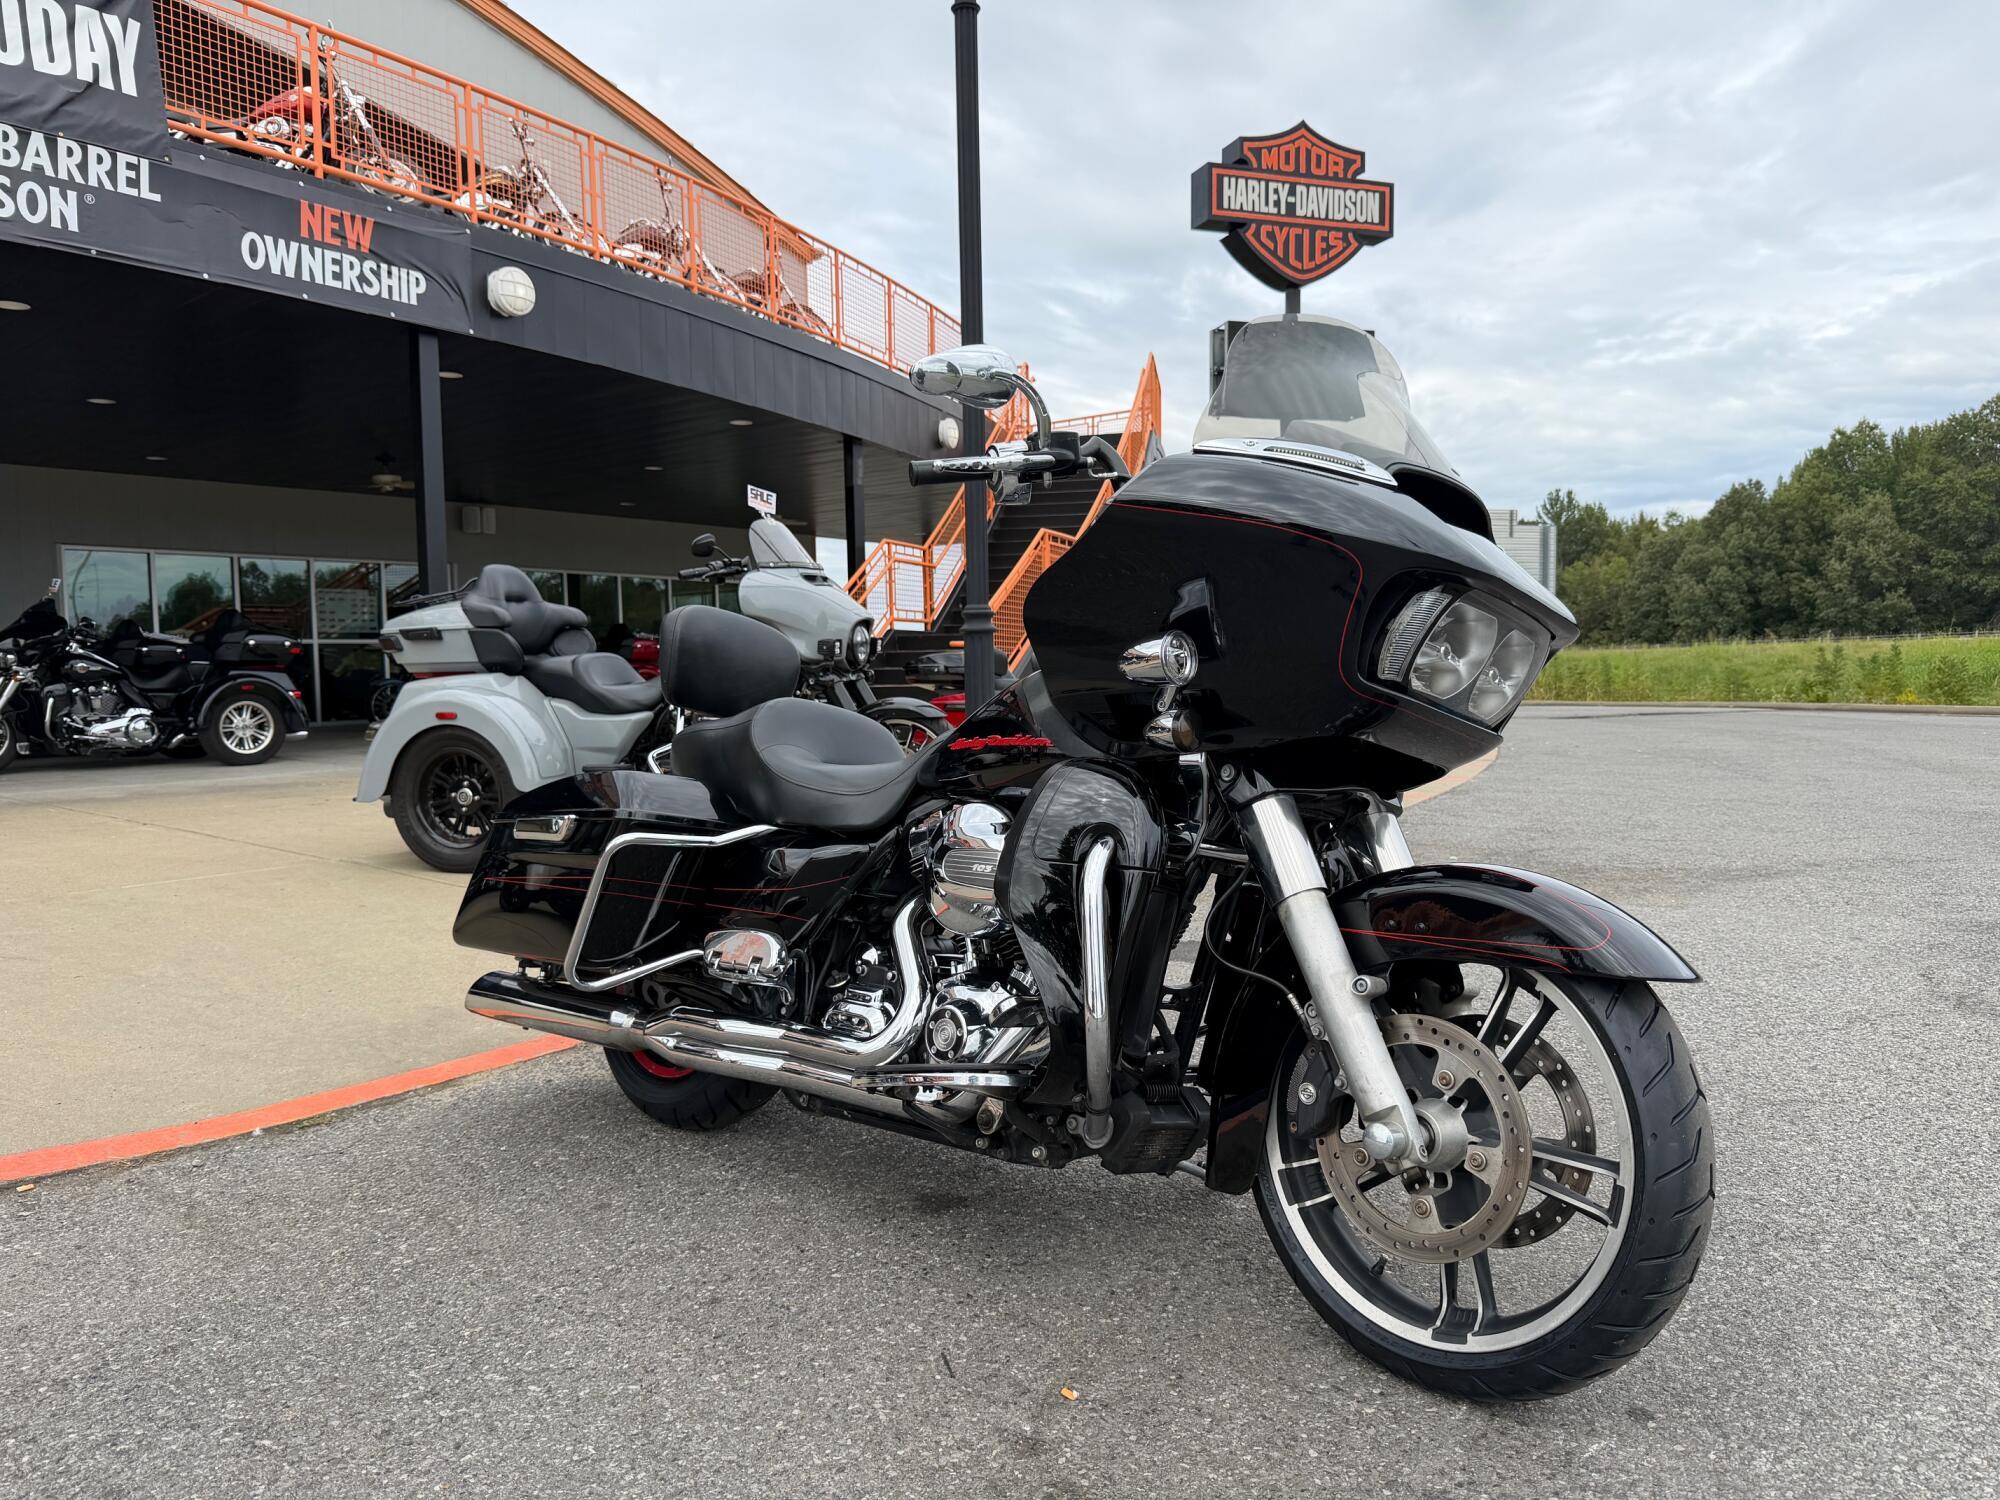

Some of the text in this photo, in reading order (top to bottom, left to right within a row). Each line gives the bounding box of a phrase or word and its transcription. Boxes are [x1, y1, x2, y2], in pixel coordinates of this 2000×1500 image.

[0, 122, 161, 202] BARREL
[1261, 136, 1344, 178] MOTOR
[1222, 175, 1380, 224] HARLEY-DAVIDSON
[300, 199, 375, 254] NEW
[1260, 224, 1344, 270] CYCLES
[240, 231, 427, 306] OWNERSHIP
[750, 487, 774, 506] SALE
[971, 863, 994, 873] 103
